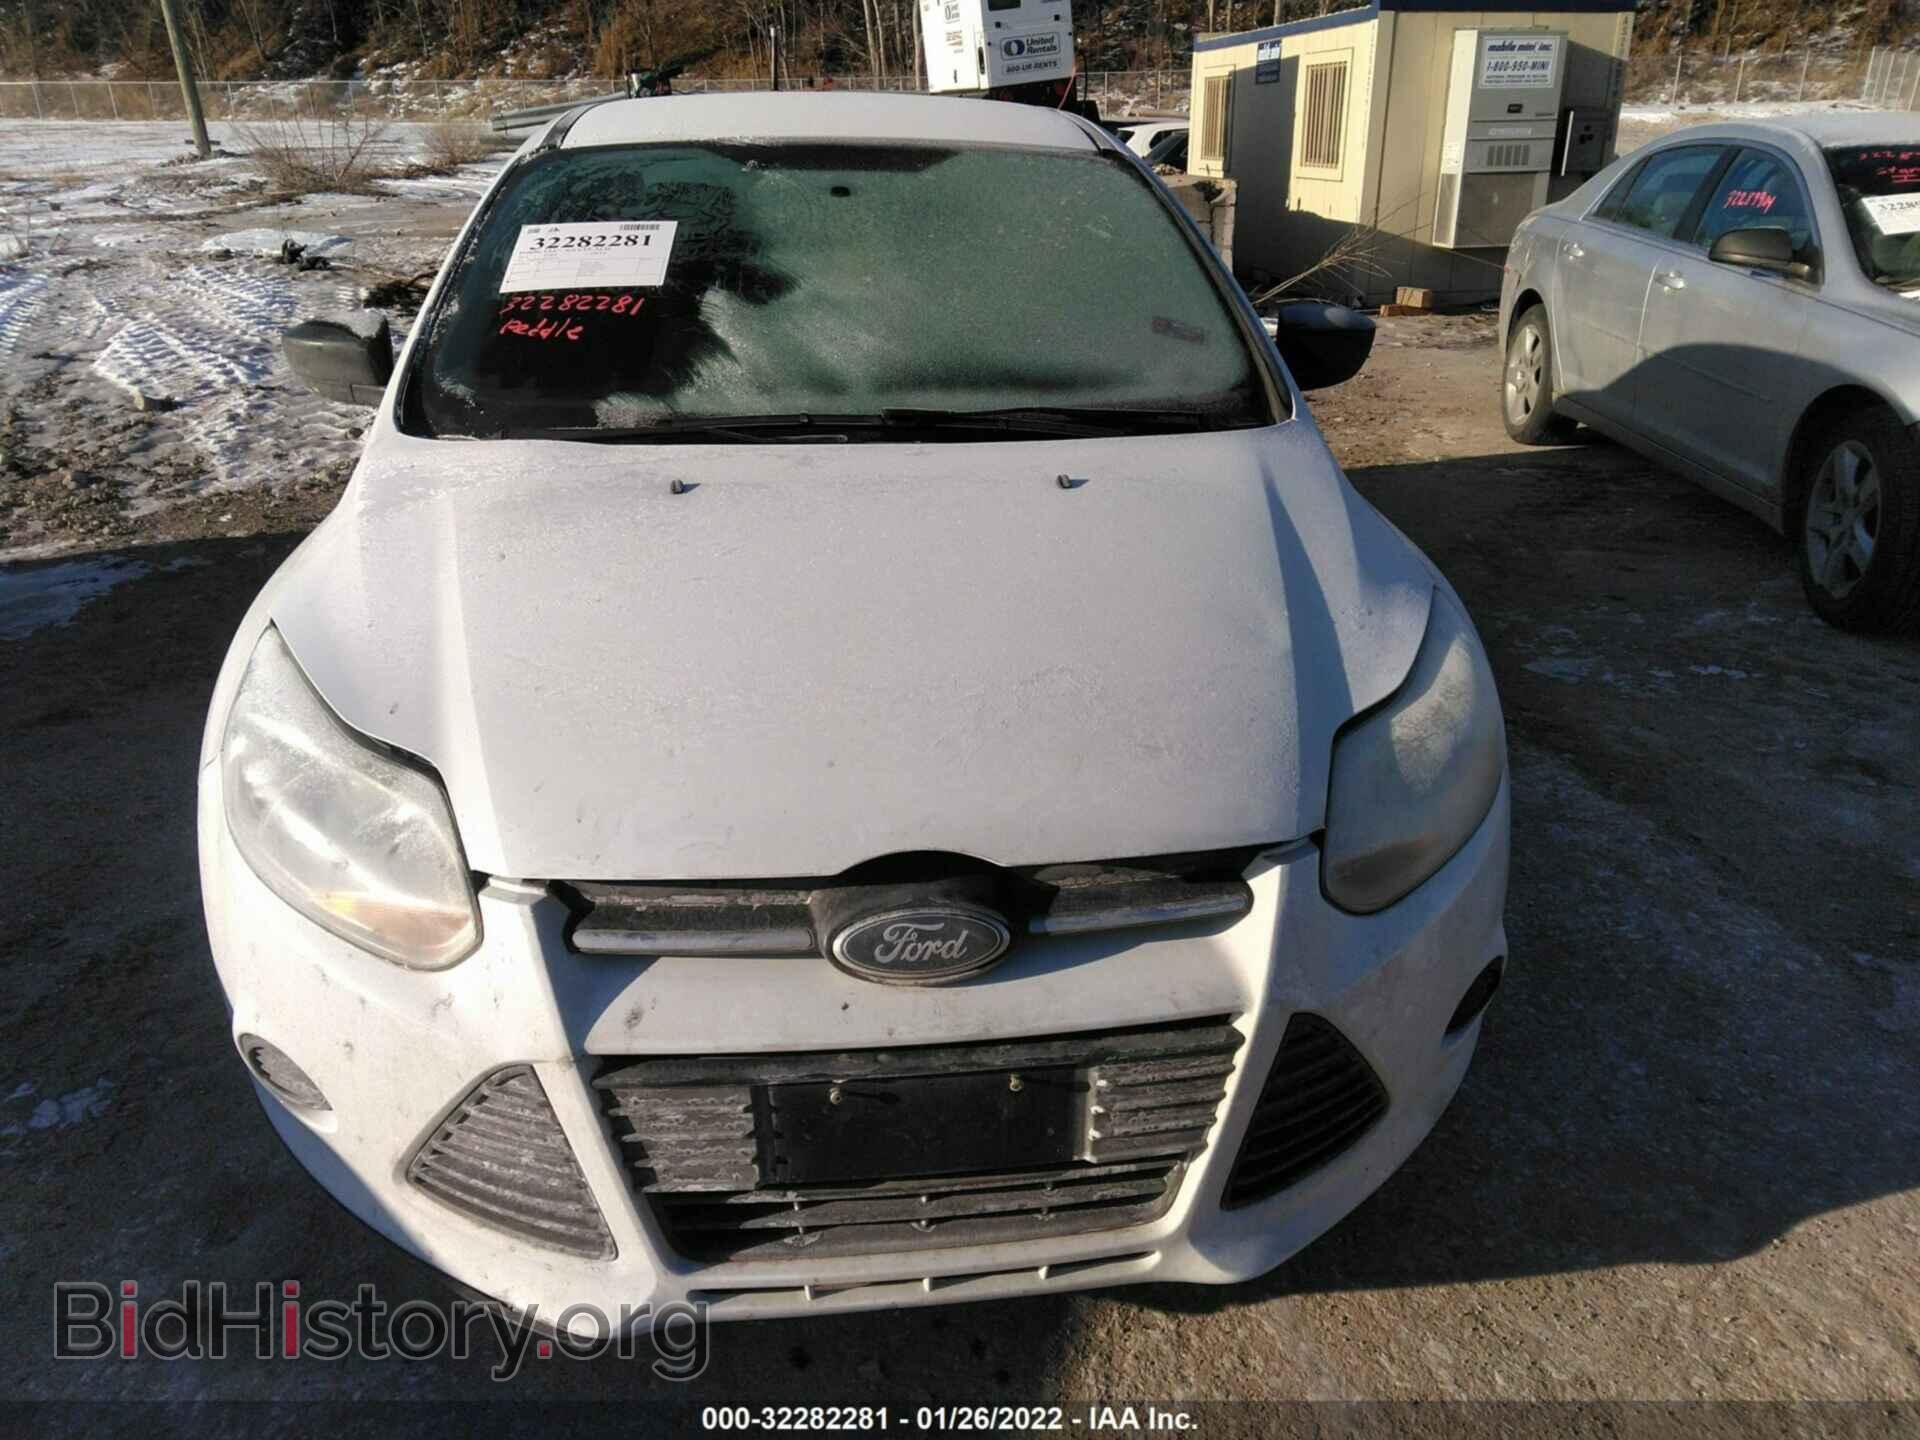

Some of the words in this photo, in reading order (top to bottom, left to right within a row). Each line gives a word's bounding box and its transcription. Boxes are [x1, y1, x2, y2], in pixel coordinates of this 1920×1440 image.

[1026, 36, 1055, 46] United
[1026, 45, 1057, 55] Rentals
[530, 235, 651, 250] 32282281
[500, 294, 645, 315] 32282281
[873, 922, 968, 964] Ford
